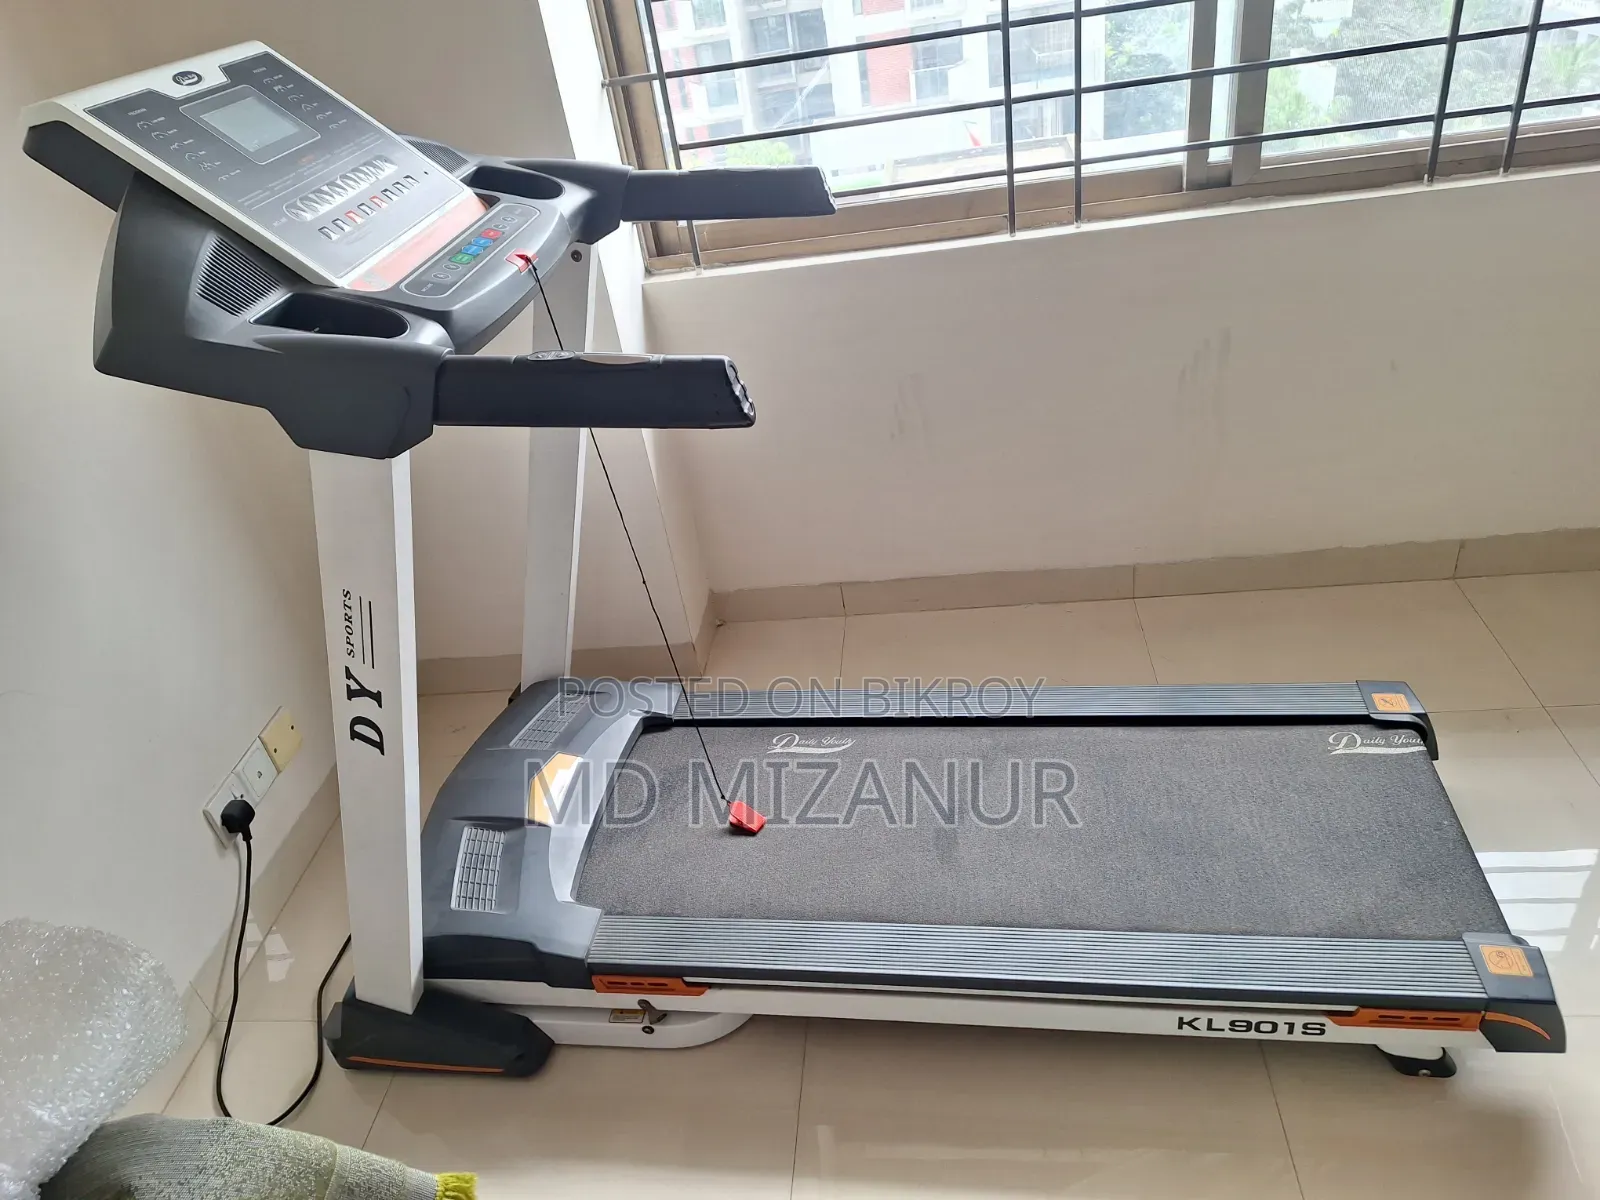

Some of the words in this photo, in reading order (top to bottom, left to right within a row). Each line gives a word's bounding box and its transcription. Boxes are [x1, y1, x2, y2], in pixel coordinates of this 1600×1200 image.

[342, 589, 356, 658] SPORTS
[345, 666, 385, 756] DY
[1328, 732, 1386, 750] Daily
[1390, 735, 1424, 745] You
[1177, 1016, 1326, 1036] KL901S
